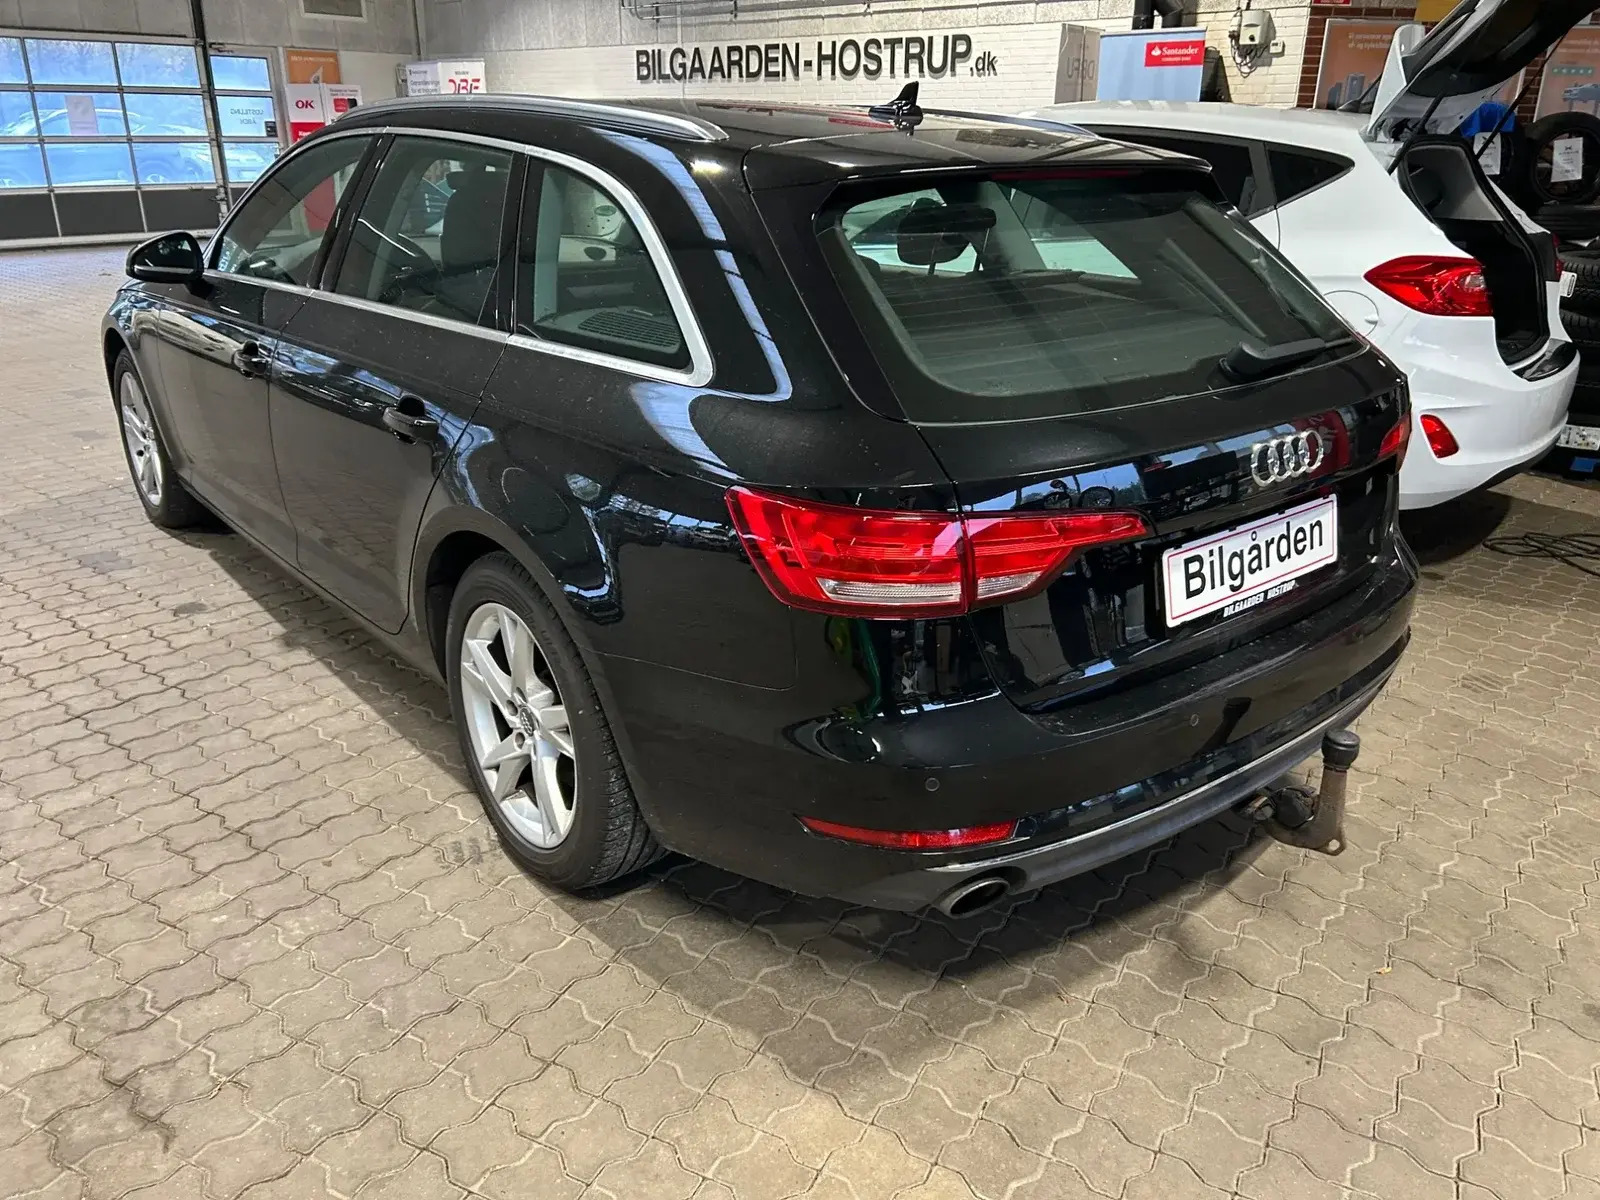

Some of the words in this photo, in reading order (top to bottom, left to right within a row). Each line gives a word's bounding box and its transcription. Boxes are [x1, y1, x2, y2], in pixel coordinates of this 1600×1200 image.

[1161, 45, 1199, 56] Santander
[295, 99, 314, 109] OK
[1183, 519, 1323, 600] Bilgården
